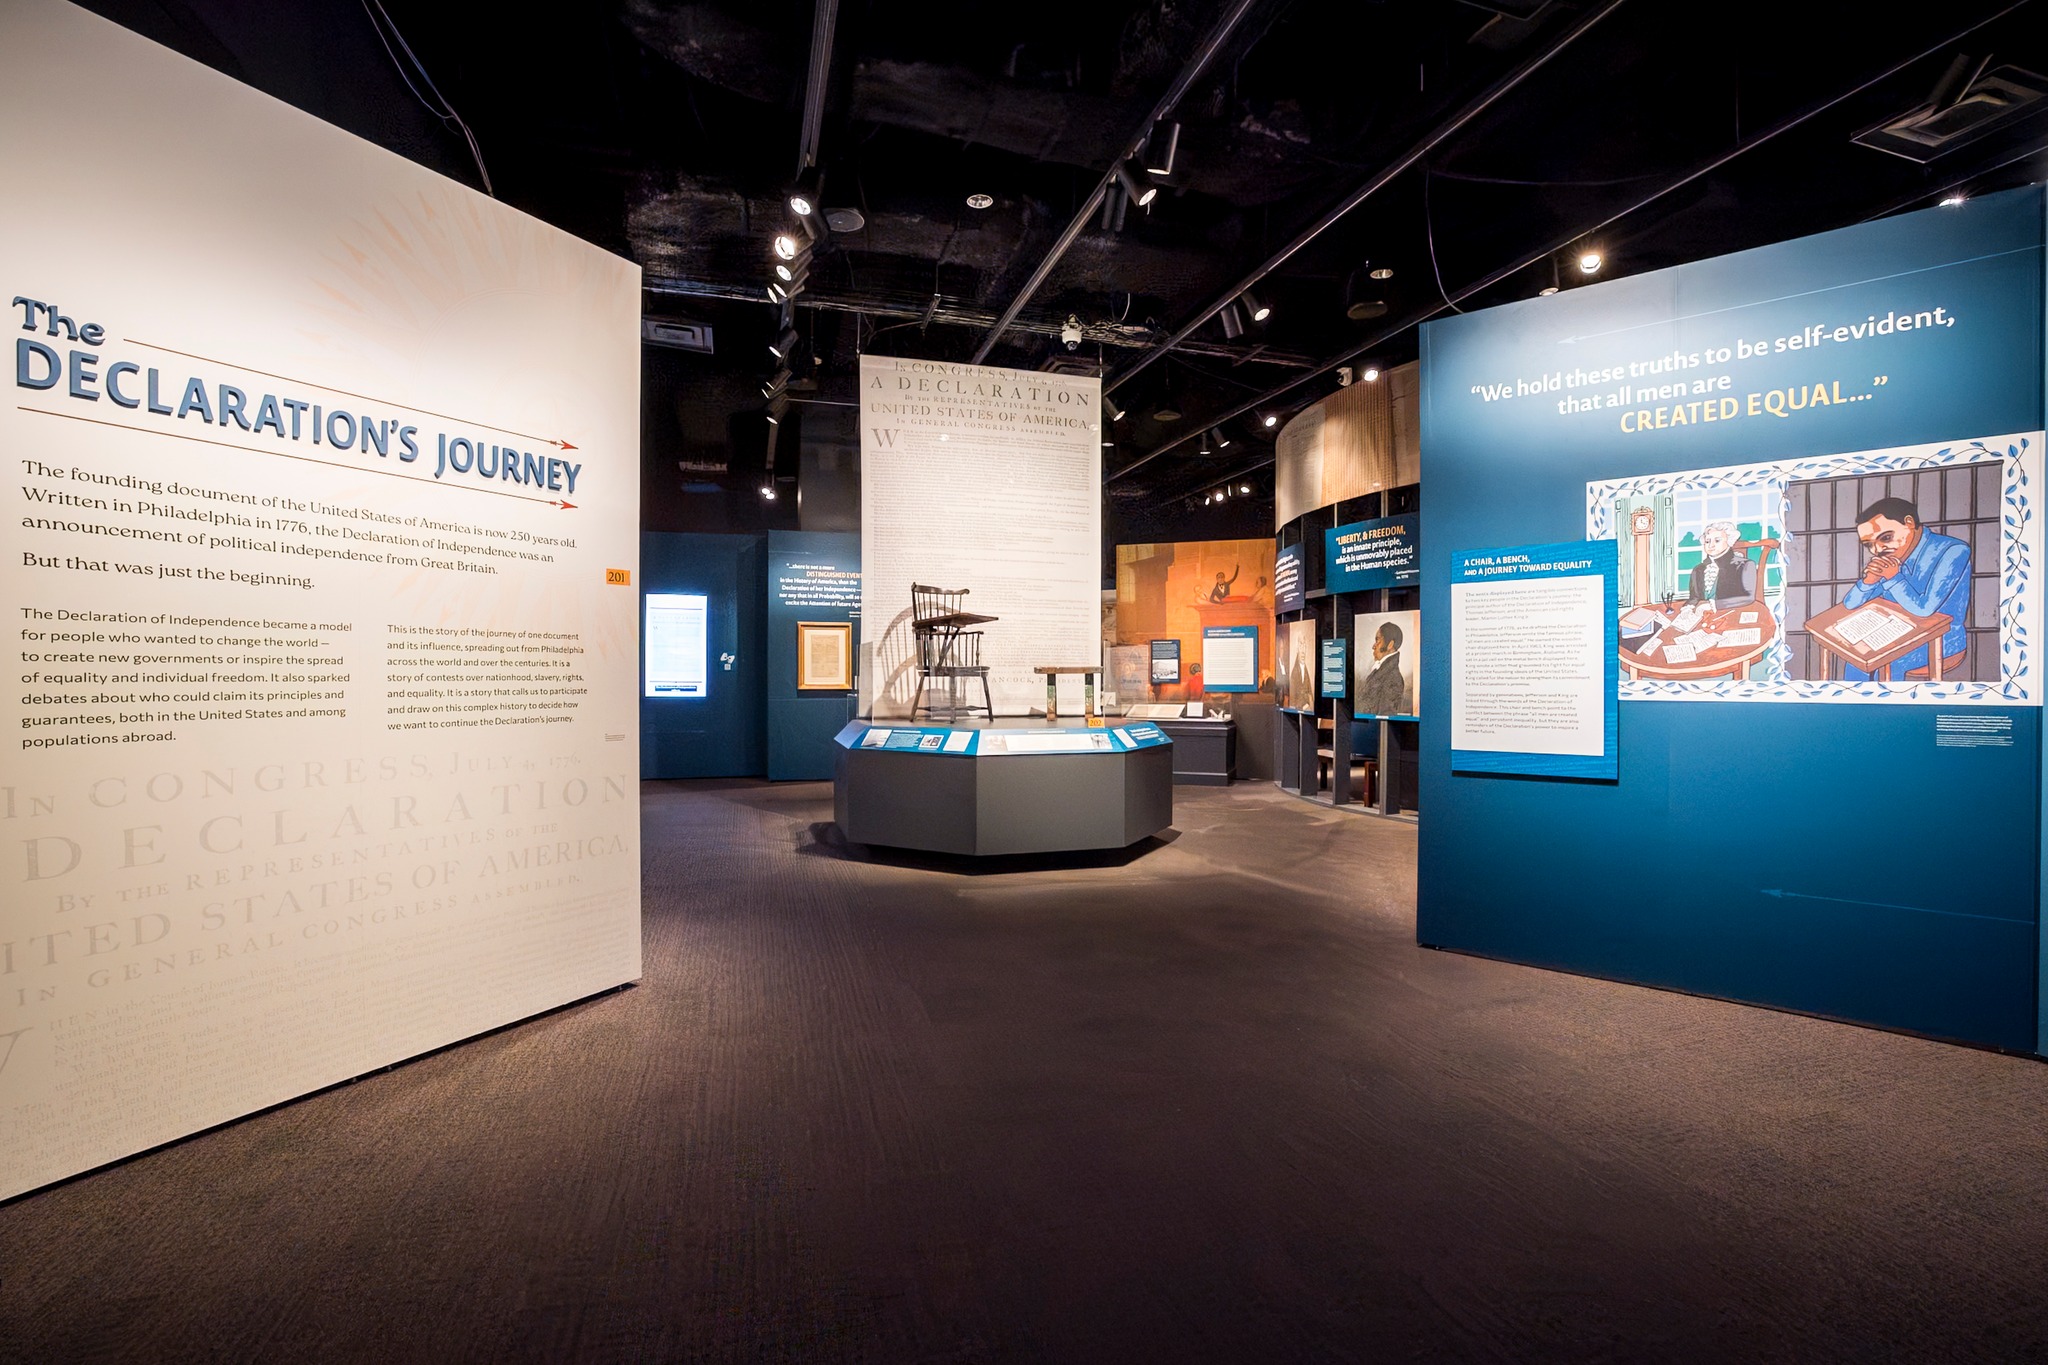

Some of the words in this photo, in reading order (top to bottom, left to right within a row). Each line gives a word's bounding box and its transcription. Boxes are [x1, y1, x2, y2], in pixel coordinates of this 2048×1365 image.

[12, 295, 105, 346] The
[1471, 382, 1512, 402] “We
[1517, 372, 1561, 396] hold
[1565, 366, 1624, 388] these
[1629, 350, 1699, 376] truths
[1704, 348, 1731, 364] to
[1738, 339, 1768, 359] be
[1774, 307, 1955, 353] self-evident,
[871, 376, 882, 388] A
[899, 377, 1088, 406] DECLARATION
[1558, 395, 1602, 414] that
[1606, 386, 1630, 408] all
[1636, 382, 1686, 402] men
[1692, 375, 1731, 394] are
[16, 338, 419, 463] DECLARATION’S
[434, 433, 582, 494] JOURNEY
[872, 403, 930, 415] UNITED
[938, 407, 993, 420] STATES
[999, 412, 1017, 421] OF
[1024, 415, 1089, 430] AMERICA,
[1620, 398, 1738, 433] CREATED
[22, 460, 64, 478] The
[71, 467, 162, 495] founding
[167, 482, 257, 505] document
[262, 497, 278, 507] of
[282, 499, 306, 511] the
[311, 502, 358, 518] United
[362, 509, 401, 524] States
[405, 517, 417, 526] of
[420, 518, 470, 534] America
[474, 526, 482, 535] is
[486, 530, 508, 538] now
[511, 530, 530, 541] 250
[533, 536, 558, 546] years
[560, 538, 577, 548] old.
[22, 486, 108, 510] Written
[114, 499, 132, 512] in
[138, 502, 251, 527] Philadelphia
[257, 517, 271, 529] in
[277, 519, 311, 535] 1776,
[316, 525, 338, 537] the
[343, 528, 419, 546] Declaration
[422, 539, 435, 548] of
[438, 540, 516, 558] Independence
[519, 552, 539, 560] was
[1362, 531, 1368, 540] &
[1368, 525, 1406, 539] FREEDOM,
[22, 518, 182, 543] announcement
[188, 533, 206, 544] of
[210, 536, 276, 552] political
[281, 542, 382, 562] independence
[387, 553, 418, 566] from
[421, 558, 454, 570] Great
[458, 561, 498, 574] Britain.
[1356, 549, 1389, 561] unmovably
[1390, 545, 1412, 558] placed
[1372, 537, 1401, 550] principle,
[23, 552, 60, 568] But
[66, 556, 109, 572] that
[114, 564, 153, 575] was
[158, 564, 192, 579] just
[197, 568, 225, 580] the
[230, 570, 314, 590] beginning.
[1361, 561, 1382, 570] Human
[1470, 558, 1495, 566] CHAIR,
[1502, 555, 1530, 564] BENCH,
[1484, 566, 1518, 576] JOURNEY
[1519, 562, 1551, 572] TOWARD
[1553, 560, 1592, 572] EQUALITY
[608, 572, 624, 582] 201
[20, 608, 53, 620] The
[58, 610, 146, 623] Declaration
[151, 614, 166, 624] of
[170, 615, 260, 628] Independence
[263, 619, 308, 630] became
[320, 622, 352, 631] model
[20, 629, 46, 640] for
[51, 632, 104, 644] people
[108, 632, 140, 643] who
[144, 635, 196, 644] wanted
[200, 636, 214, 645] to
[217, 636, 261, 648] change
[264, 637, 283, 646] the
[286, 638, 318, 647] world
[387, 641, 404, 650] and
[407, 642, 418, 650] its
[420, 642, 463, 652] influence,
[464, 644, 504, 654] spreading
[521, 644, 540, 653] from
[541, 645, 584, 657] Philadelphia
[20, 652, 39, 662] to
[44, 652, 94, 662] create
[133, 655, 223, 665] governments
[243, 654, 283, 666] inspire
[286, 656, 304, 664] the
[307, 656, 343, 666] spread
[21, 672, 40, 683] of
[44, 672, 108, 685] equality
[112, 672, 138, 683] and
[142, 672, 208, 682] individual
[212, 673, 268, 682] freedom.
[271, 673, 279, 682] It
[282, 673, 305, 682] also
[308, 673, 350, 684] sparked
[387, 674, 412, 683] story
[414, 673, 424, 682] of
[426, 674, 464, 682] contests
[486, 673, 533, 682] nationhood,
[534, 674, 561, 682] slavery,
[562, 674, 584, 682] rights,
[89, 754, 433, 808] CONGRESS,
[21, 775, 626, 882] DECLARATION
[186, 828, 495, 891] REPRESENTATIVES
[201, 872, 392, 931] STATES
[412, 860, 460, 889] OF
[88, 932, 283, 988] GENERAL
[302, 895, 457, 939] CONGRESS
